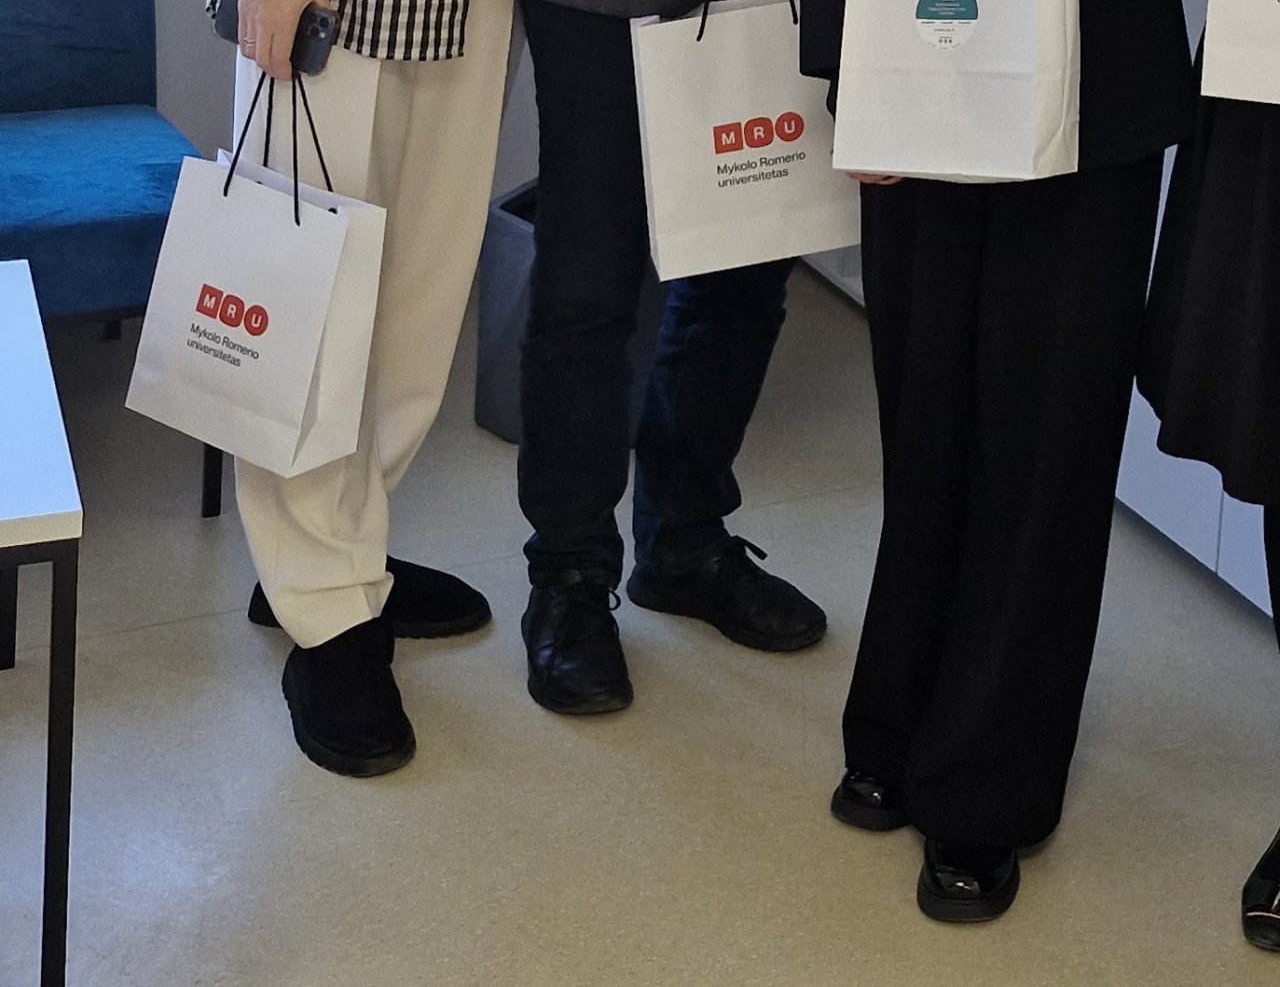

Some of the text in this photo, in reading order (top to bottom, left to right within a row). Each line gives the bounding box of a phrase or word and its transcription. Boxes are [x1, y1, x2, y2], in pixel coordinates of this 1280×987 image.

[718, 116, 799, 149] MRU
[717, 151, 806, 175] Mykolo Romerio
[718, 168, 789, 188] universitetas
[200, 291, 265, 331] MRU
[187, 338, 242, 367] universitetas
[190, 323, 260, 360] Mykolo Romerio
